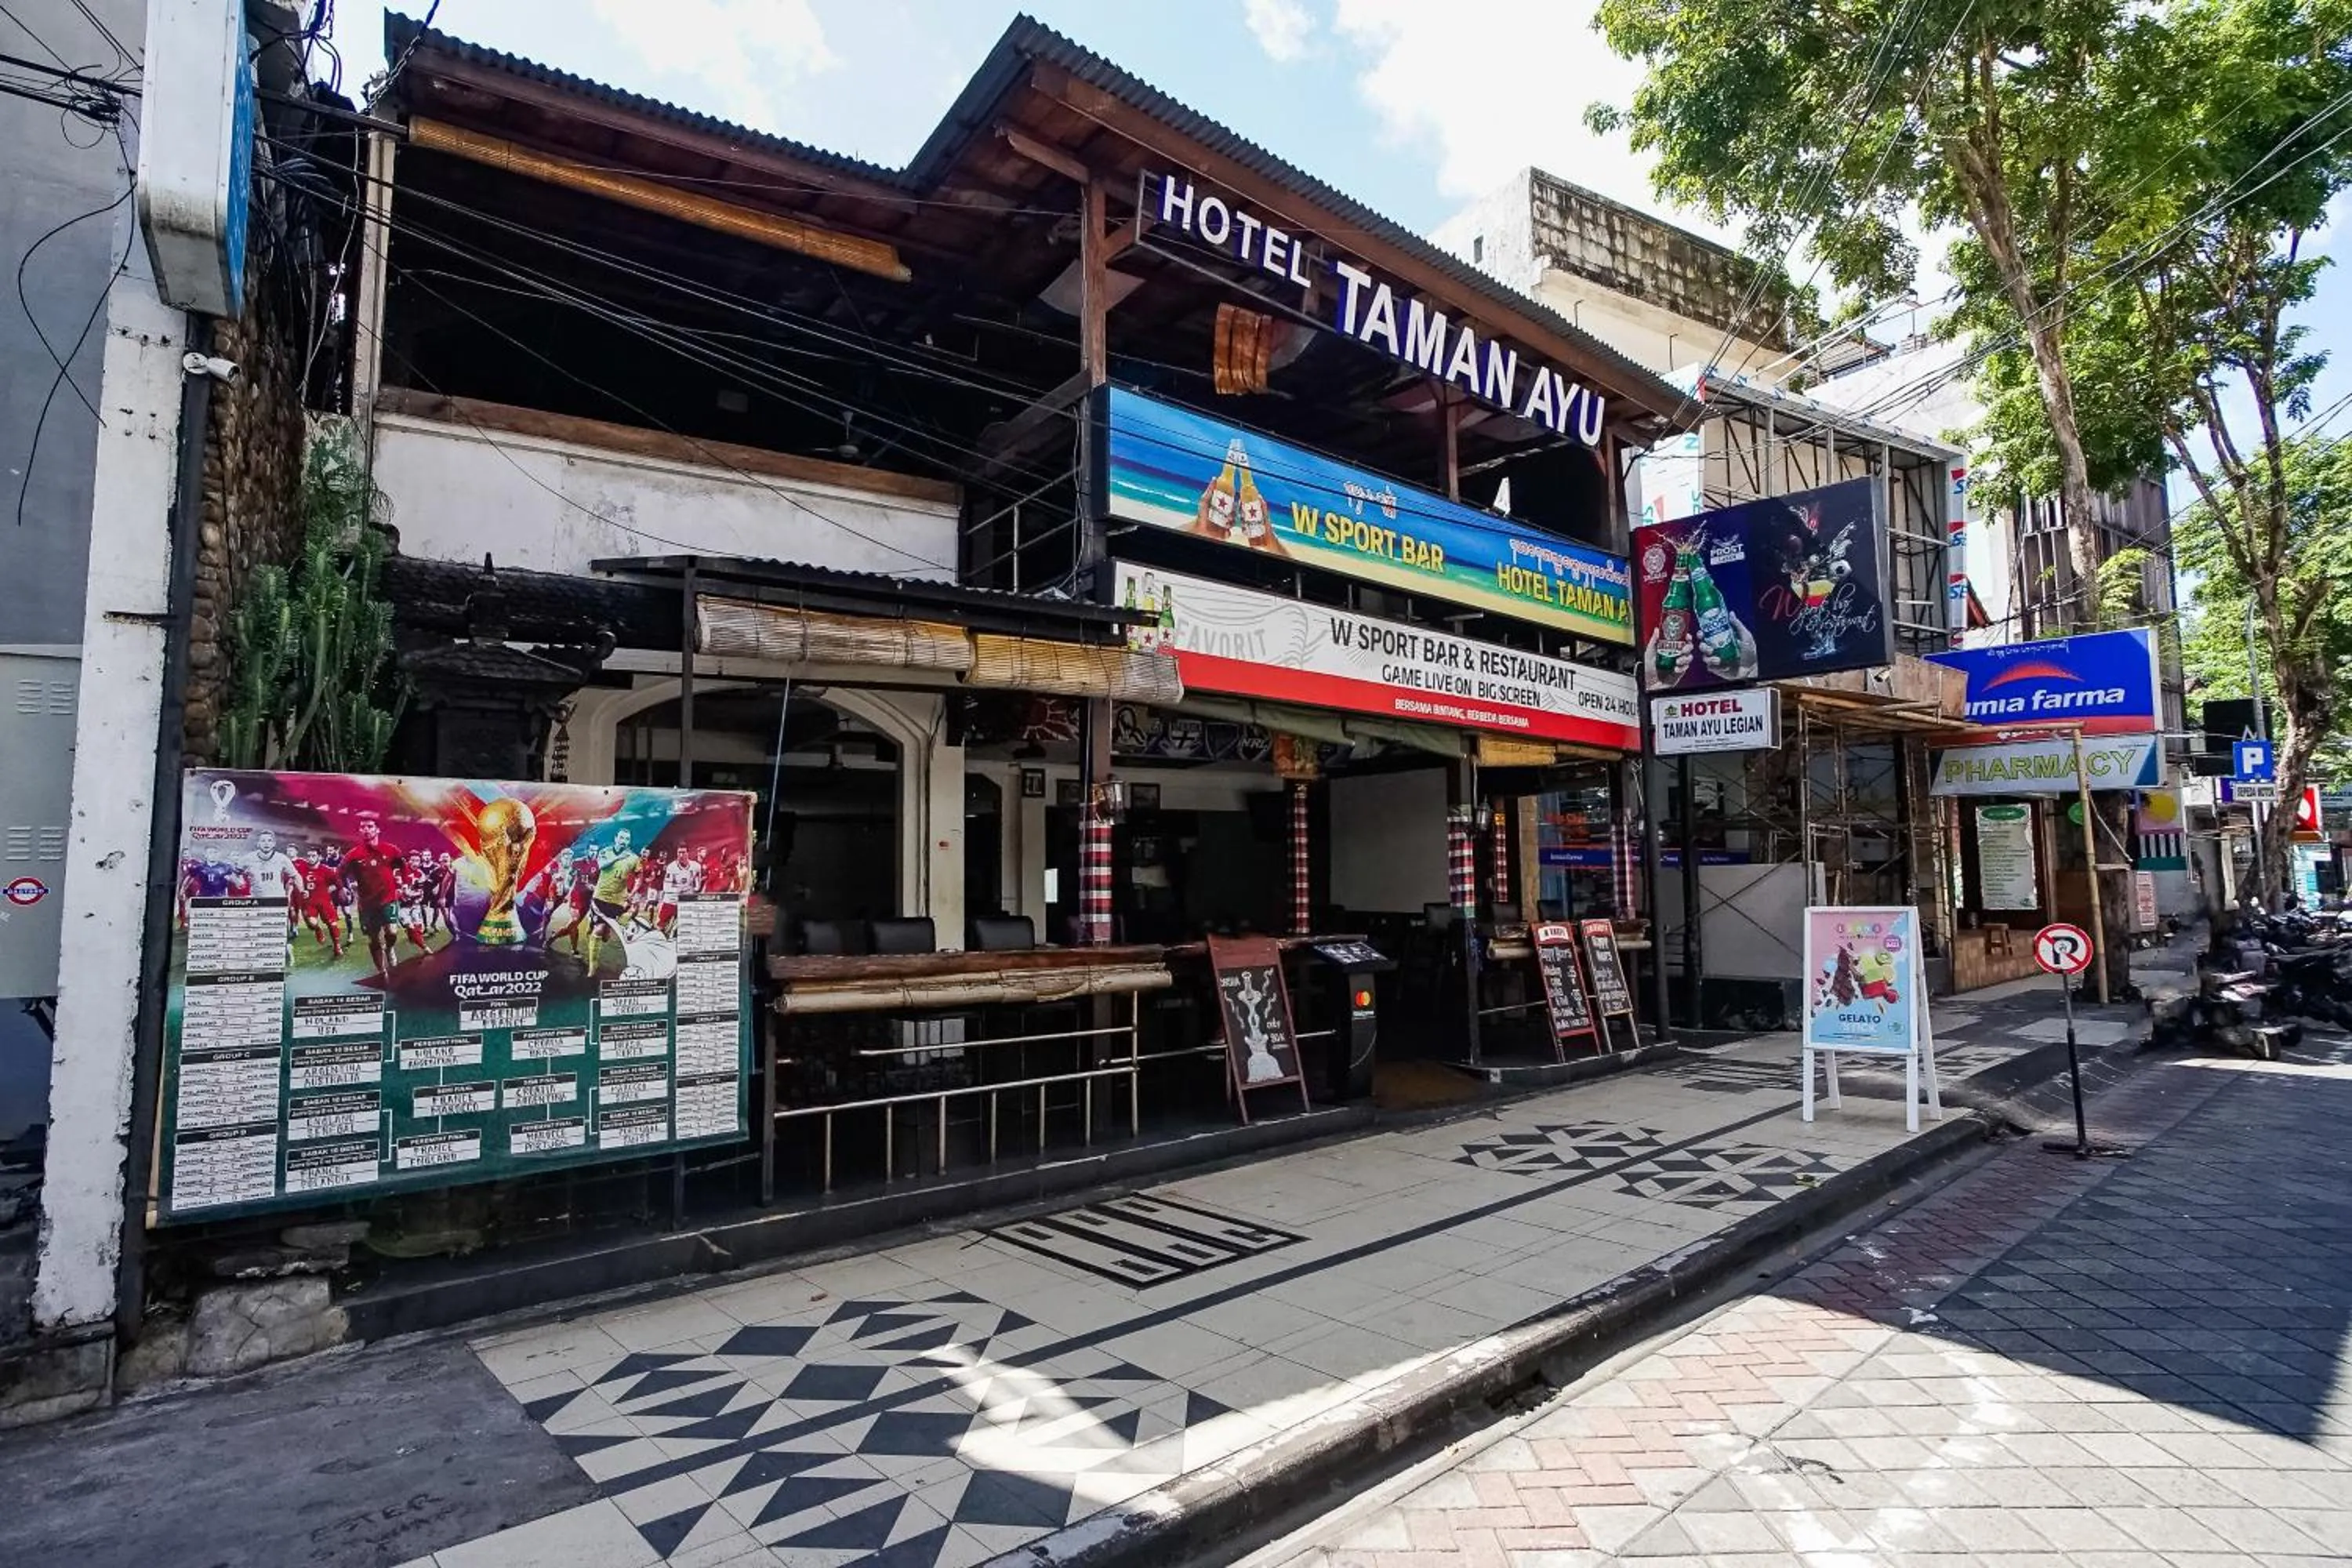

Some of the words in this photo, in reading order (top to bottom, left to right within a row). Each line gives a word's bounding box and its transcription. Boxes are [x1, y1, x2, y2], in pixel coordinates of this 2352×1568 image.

[1162, 175, 1312, 289] HOTEL
[1335, 260, 1518, 408] TAMAN
[1523, 365, 1605, 447] AYU
[1291, 501, 1319, 537] W
[1324, 513, 1396, 560] SPORT
[1402, 534, 1444, 573] BAR
[1496, 561, 1554, 603] HOTEL
[1556, 579, 1615, 620] TAMAN
[1176, 618, 1268, 660] FAVORIT
[1330, 616, 1352, 646] W
[1357, 622, 1419, 660] SPORT
[1423, 641, 1459, 670] BAR
[1464, 648, 1475, 671] &
[1479, 649, 1577, 690] RESTAURANT
[1382, 663, 1422, 688] GAME
[1425, 671, 1453, 694] LIVE
[1454, 677, 1472, 695] ON
[1478, 680, 1497, 700] BIG
[1499, 684, 1541, 708] SCREEN
[1578, 691, 1602, 710] OPEN
[2031, 687, 2125, 711] farma
[1680, 699, 1743, 717] HOTEL
[1663, 720, 1697, 739] TAMAN
[1700, 719, 1721, 736] AYU
[1724, 714, 1764, 734] LEGIAN
[1944, 749, 2137, 784] PHARMACY
[2242, 747, 2264, 774] P
[449, 974, 477, 985] FIFA
[477, 971, 524, 983] WORLD
[524, 970, 549, 981] CUP
[1838, 1014, 1881, 1024] GELATO
